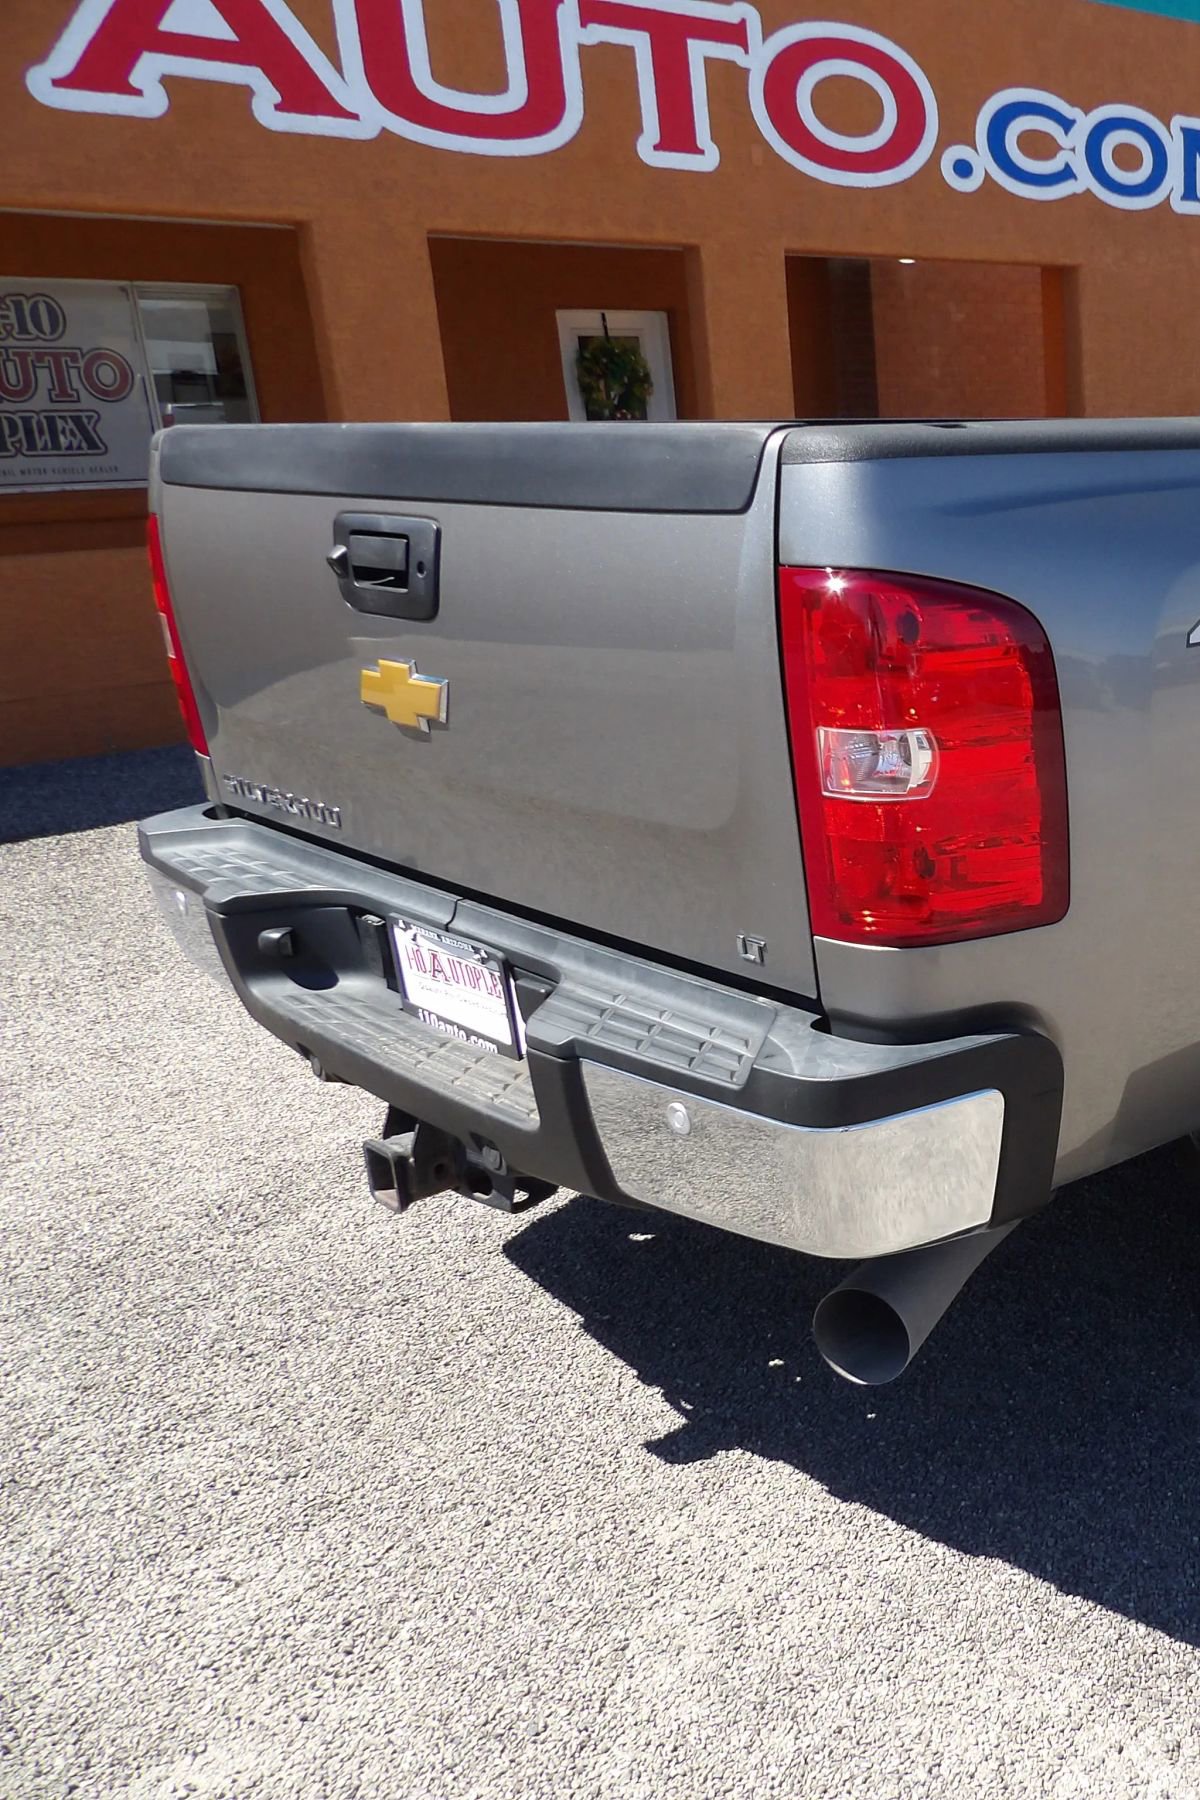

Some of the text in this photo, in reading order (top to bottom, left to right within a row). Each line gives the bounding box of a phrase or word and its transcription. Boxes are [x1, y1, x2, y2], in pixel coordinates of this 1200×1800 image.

[0, 294, 66, 341] -10
[0, 347, 134, 402] UTO
[736, 934, 767, 965] LT
